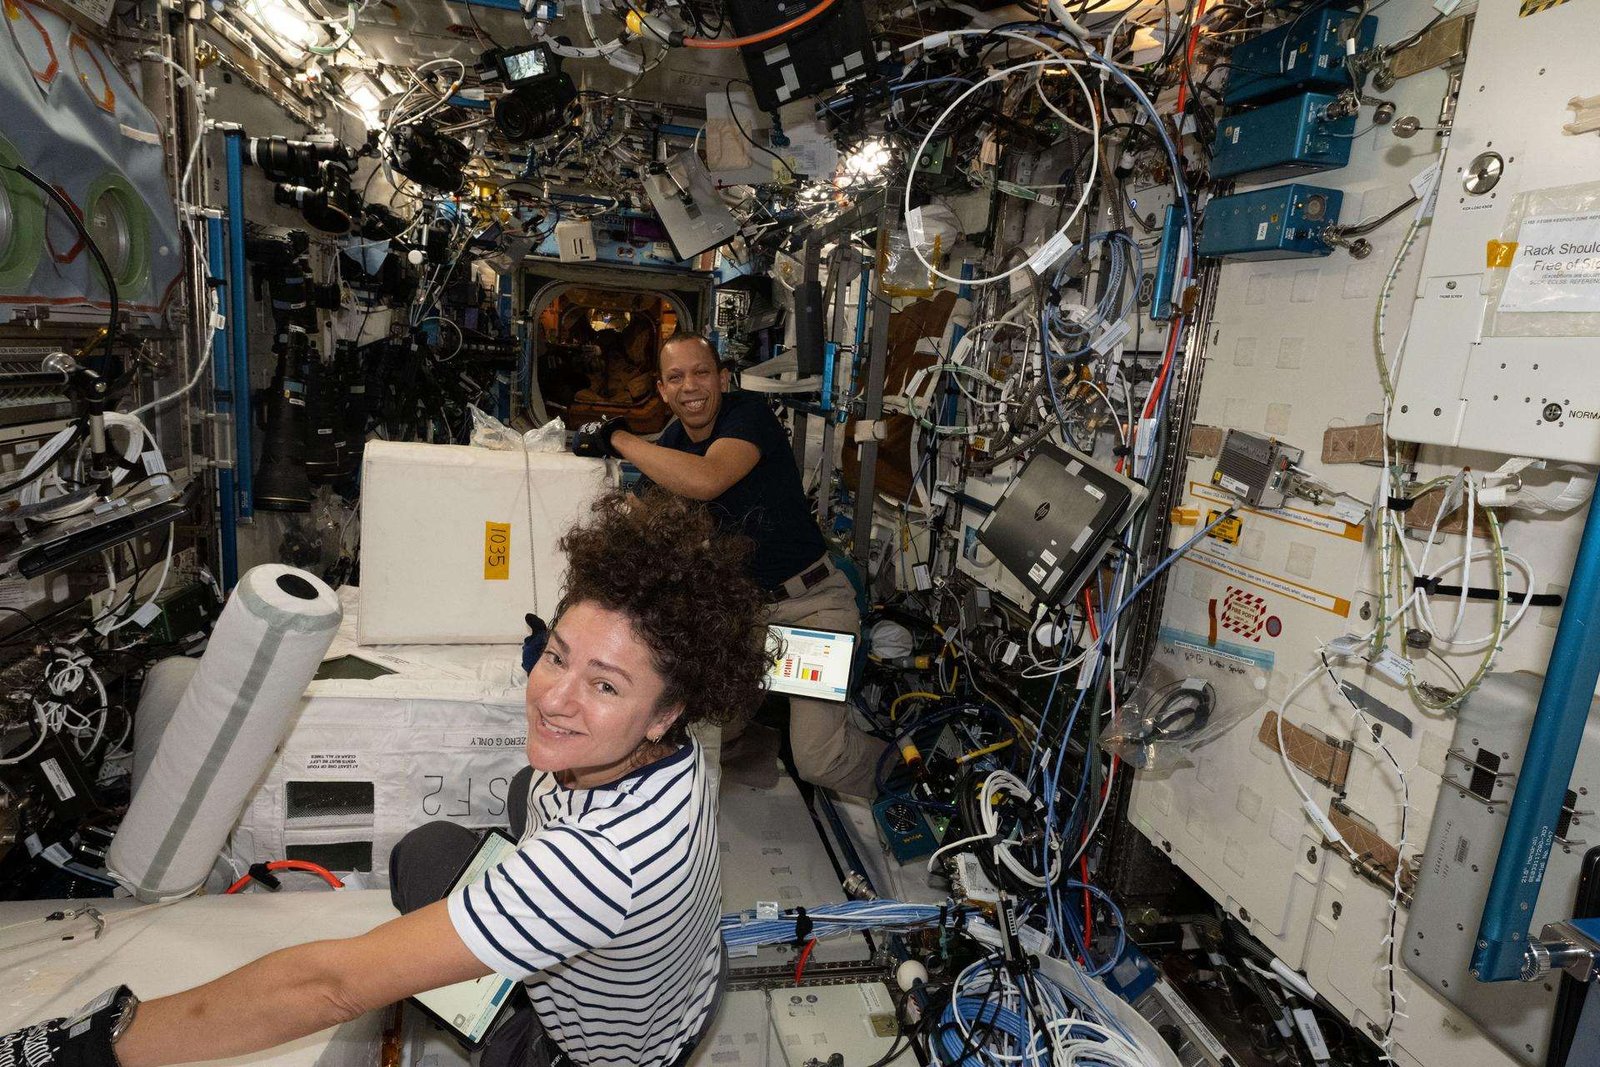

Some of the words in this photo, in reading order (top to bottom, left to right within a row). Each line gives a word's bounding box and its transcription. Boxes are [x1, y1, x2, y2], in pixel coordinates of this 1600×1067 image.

[1523, 244, 1556, 256] Rack
[1533, 260, 1563, 271] Free
[1566, 258, 1580, 270] of
[488, 528, 507, 567] 1035
[1242, 610, 1255, 621] PORT
[470, 736, 494, 747] ONLY
[496, 737, 503, 746] G
[504, 737, 527, 746] ZERO
